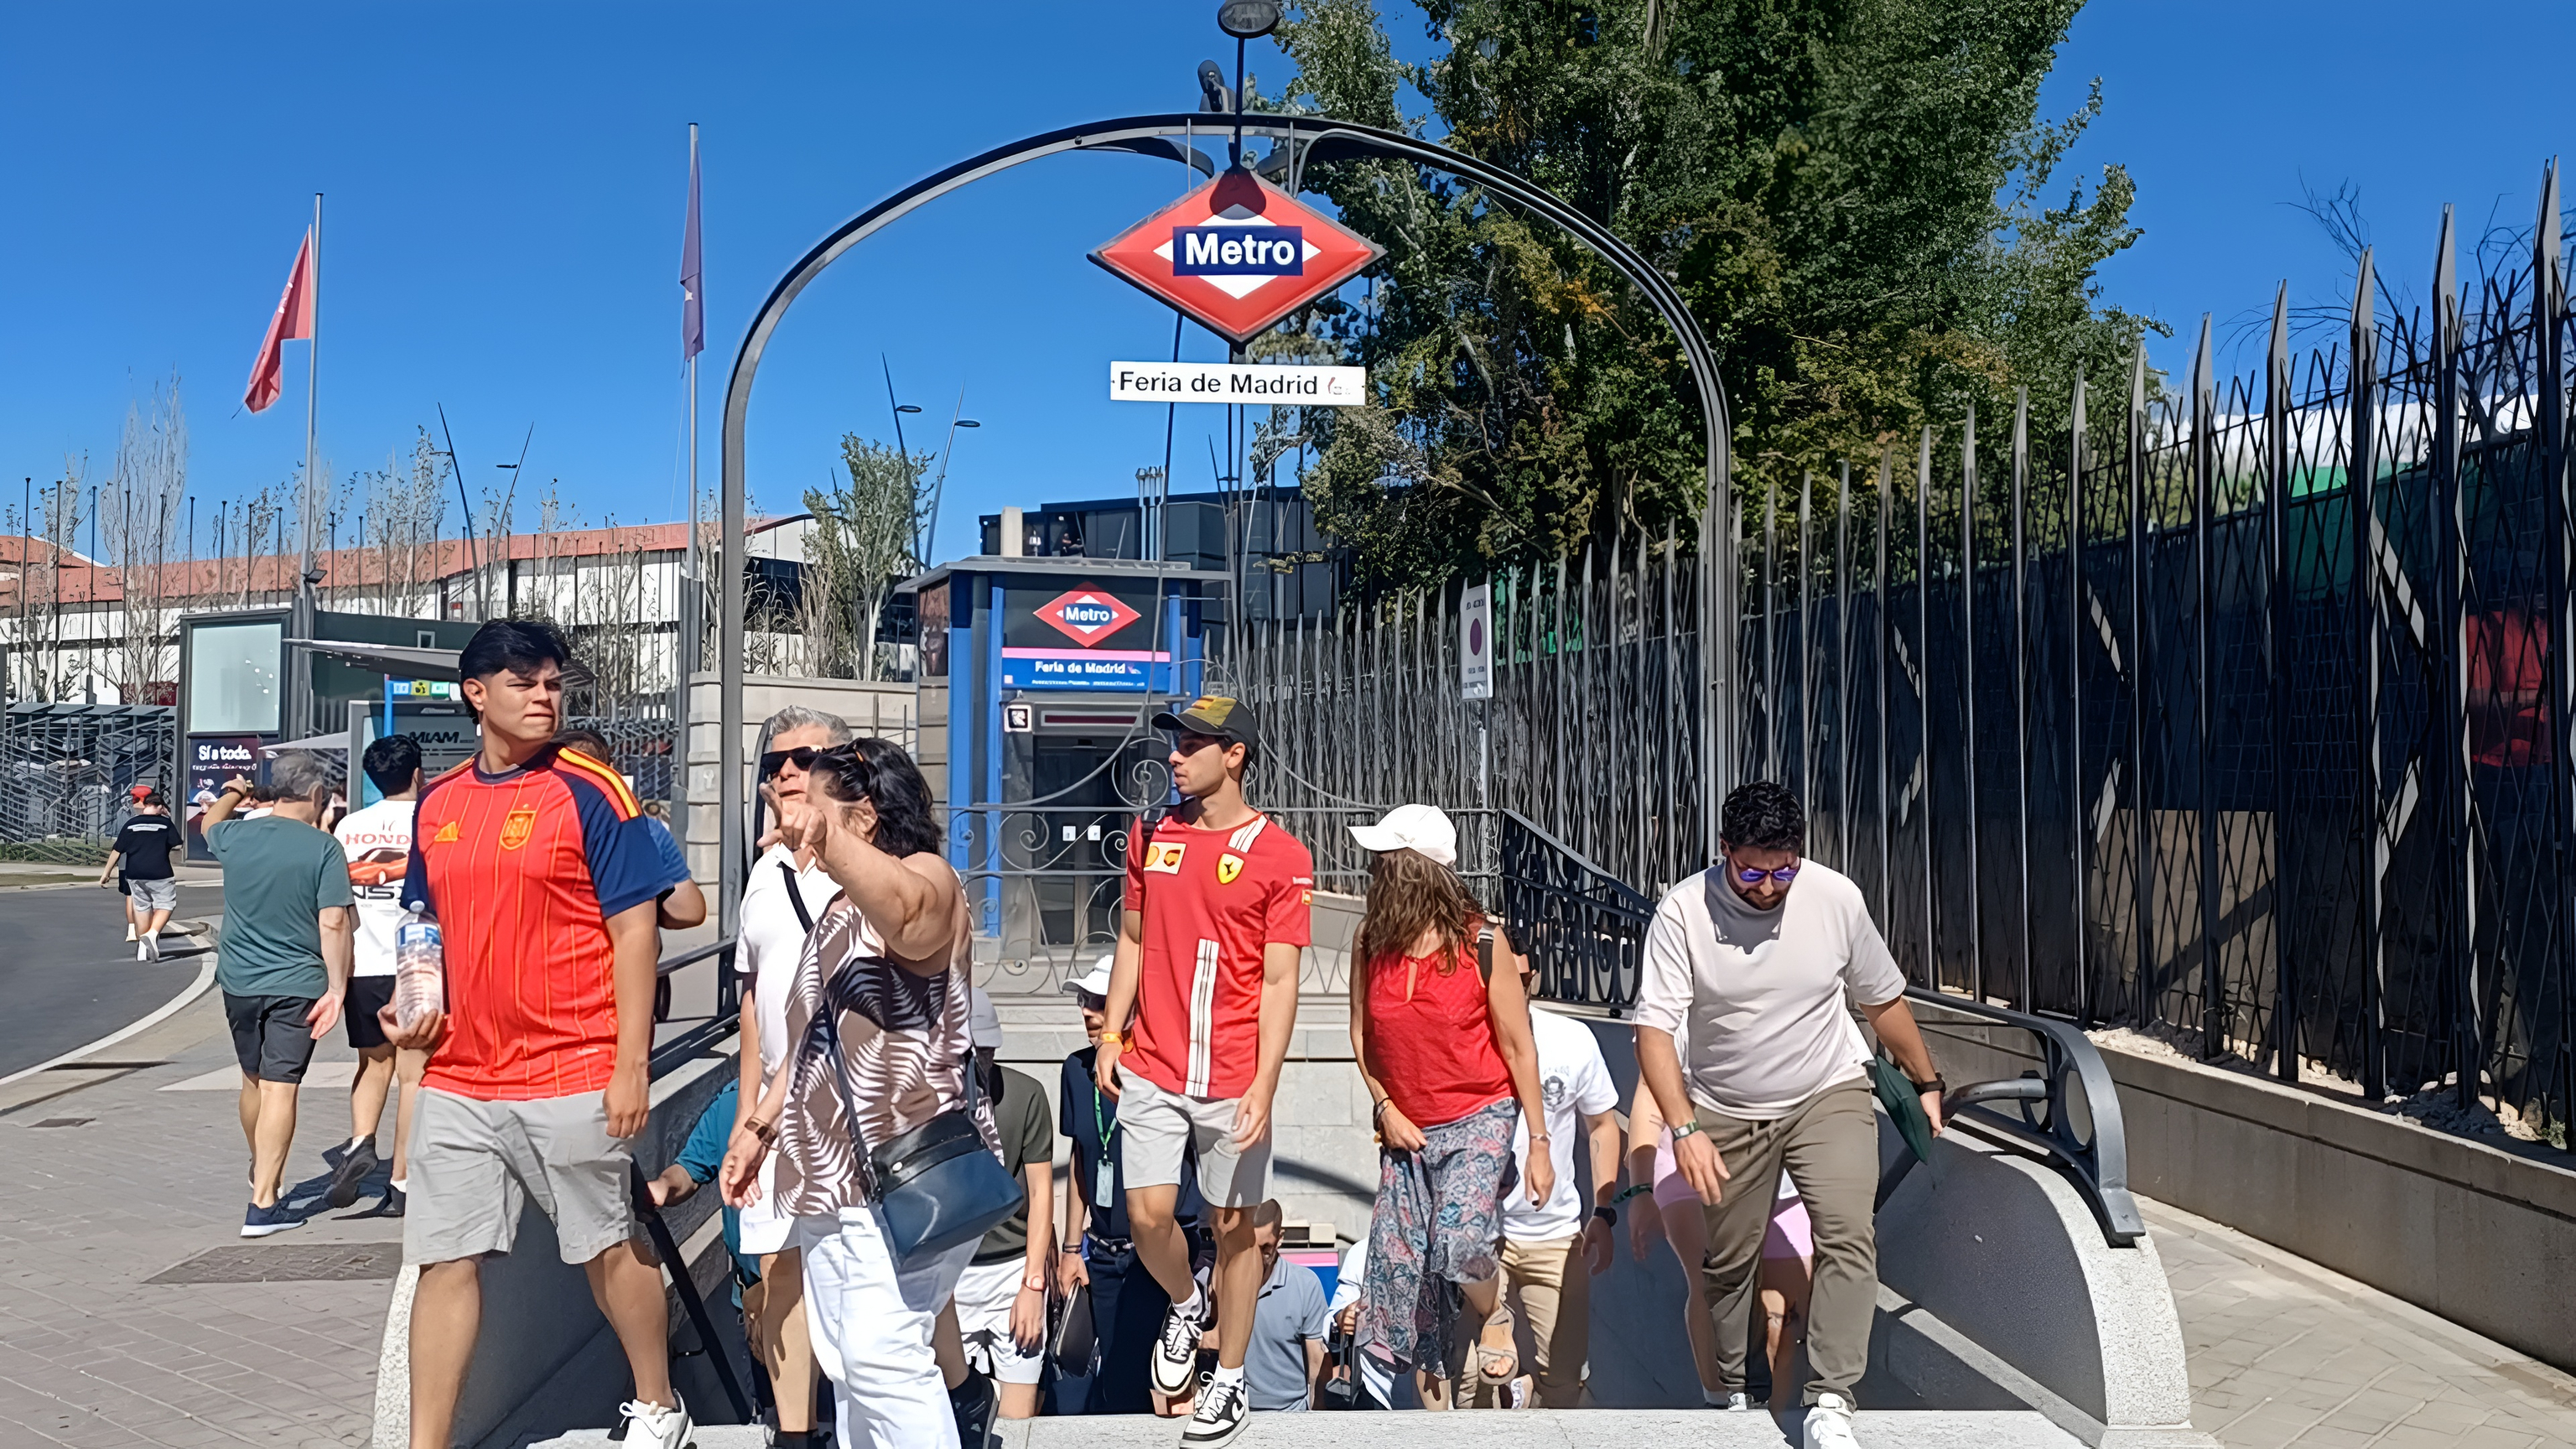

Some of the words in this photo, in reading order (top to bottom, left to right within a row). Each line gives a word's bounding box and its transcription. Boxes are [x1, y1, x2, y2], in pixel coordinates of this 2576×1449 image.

[1186, 232, 1296, 266] Metro
[1119, 371, 1182, 392] Feria
[1191, 373, 1221, 392] de
[1231, 373, 1317, 395] Madrid
[1066, 606, 1110, 622] Metro
[1035, 661, 1064, 673] Feria
[1067, 662, 1082, 673] de
[1085, 662, 1125, 674] Madrid
[345, 834, 412, 845] HOND
